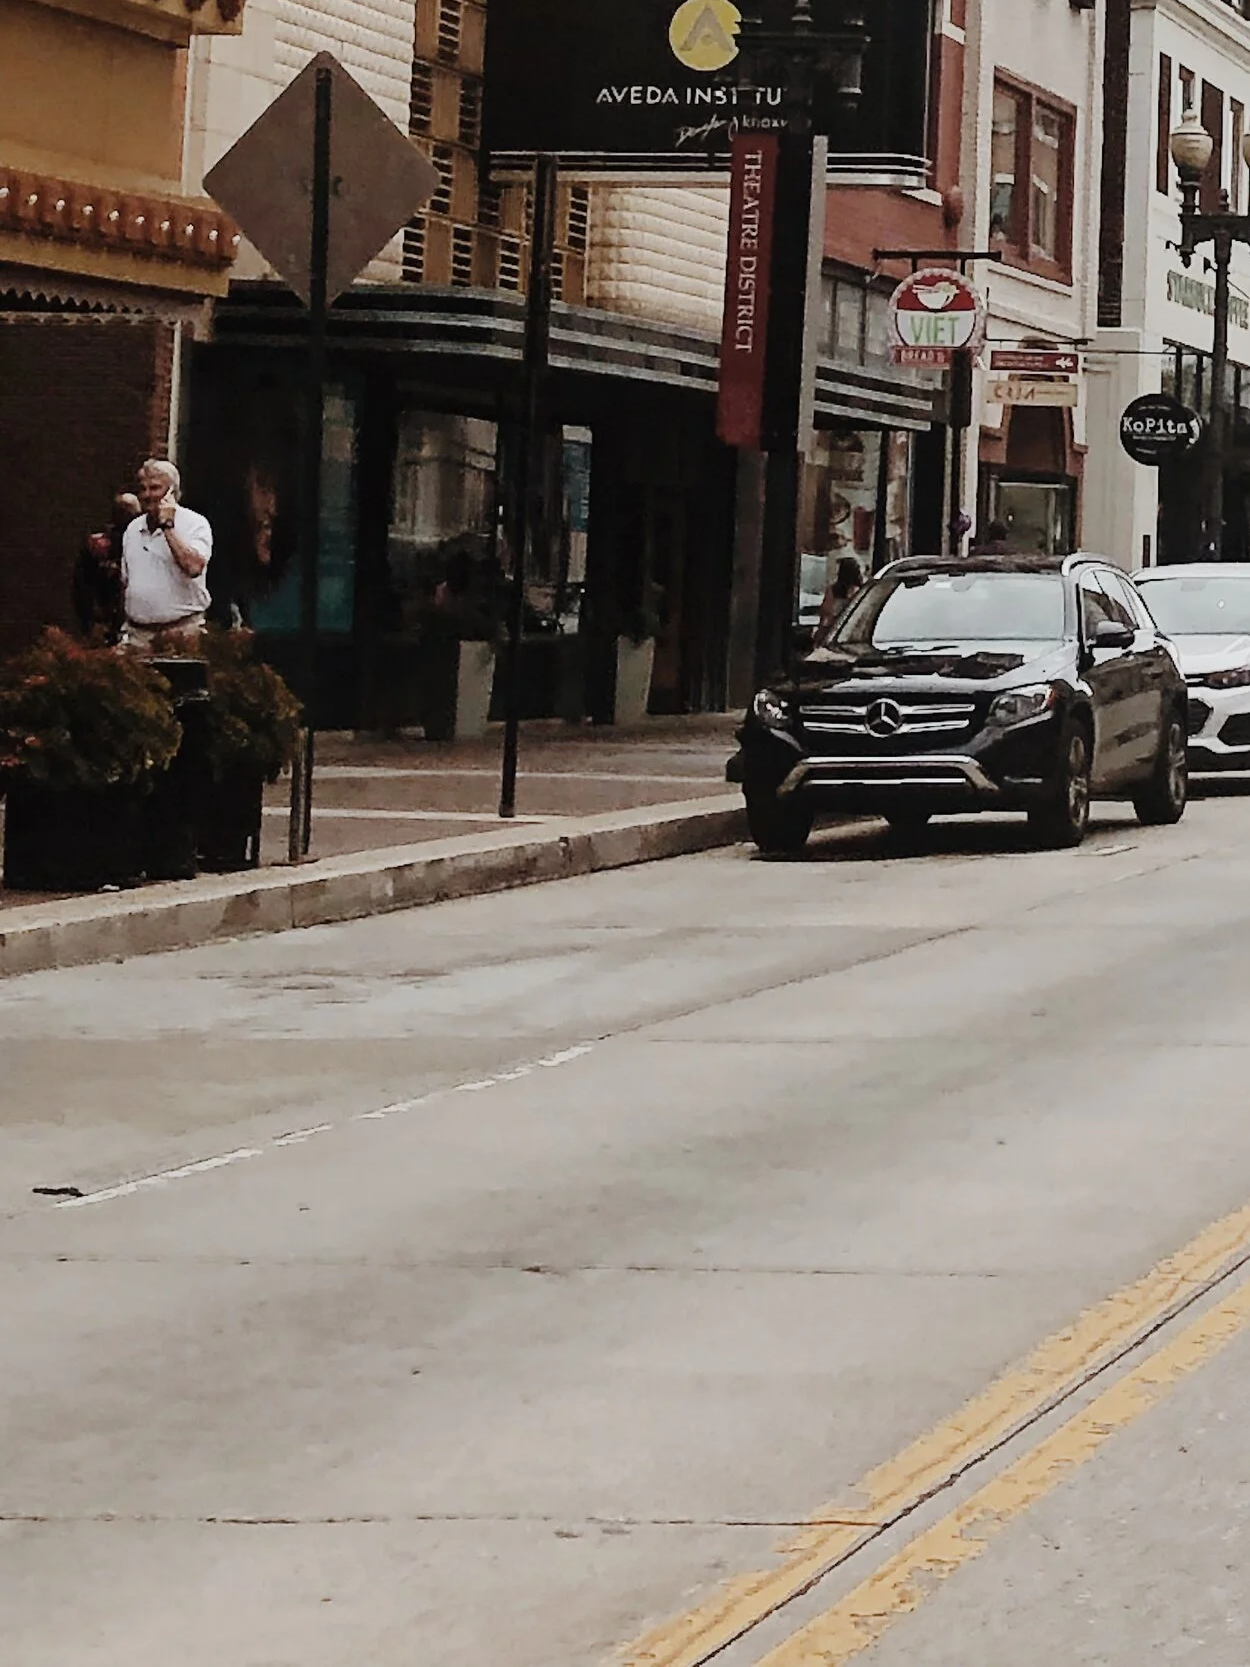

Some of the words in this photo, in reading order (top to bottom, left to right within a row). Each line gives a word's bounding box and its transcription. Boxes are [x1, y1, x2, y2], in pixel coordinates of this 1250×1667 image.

[595, 86, 680, 105] AVEDA
[740, 149, 763, 251] THEATRE
[735, 256, 757, 354] DISTRICT
[910, 315, 960, 345] VIET
